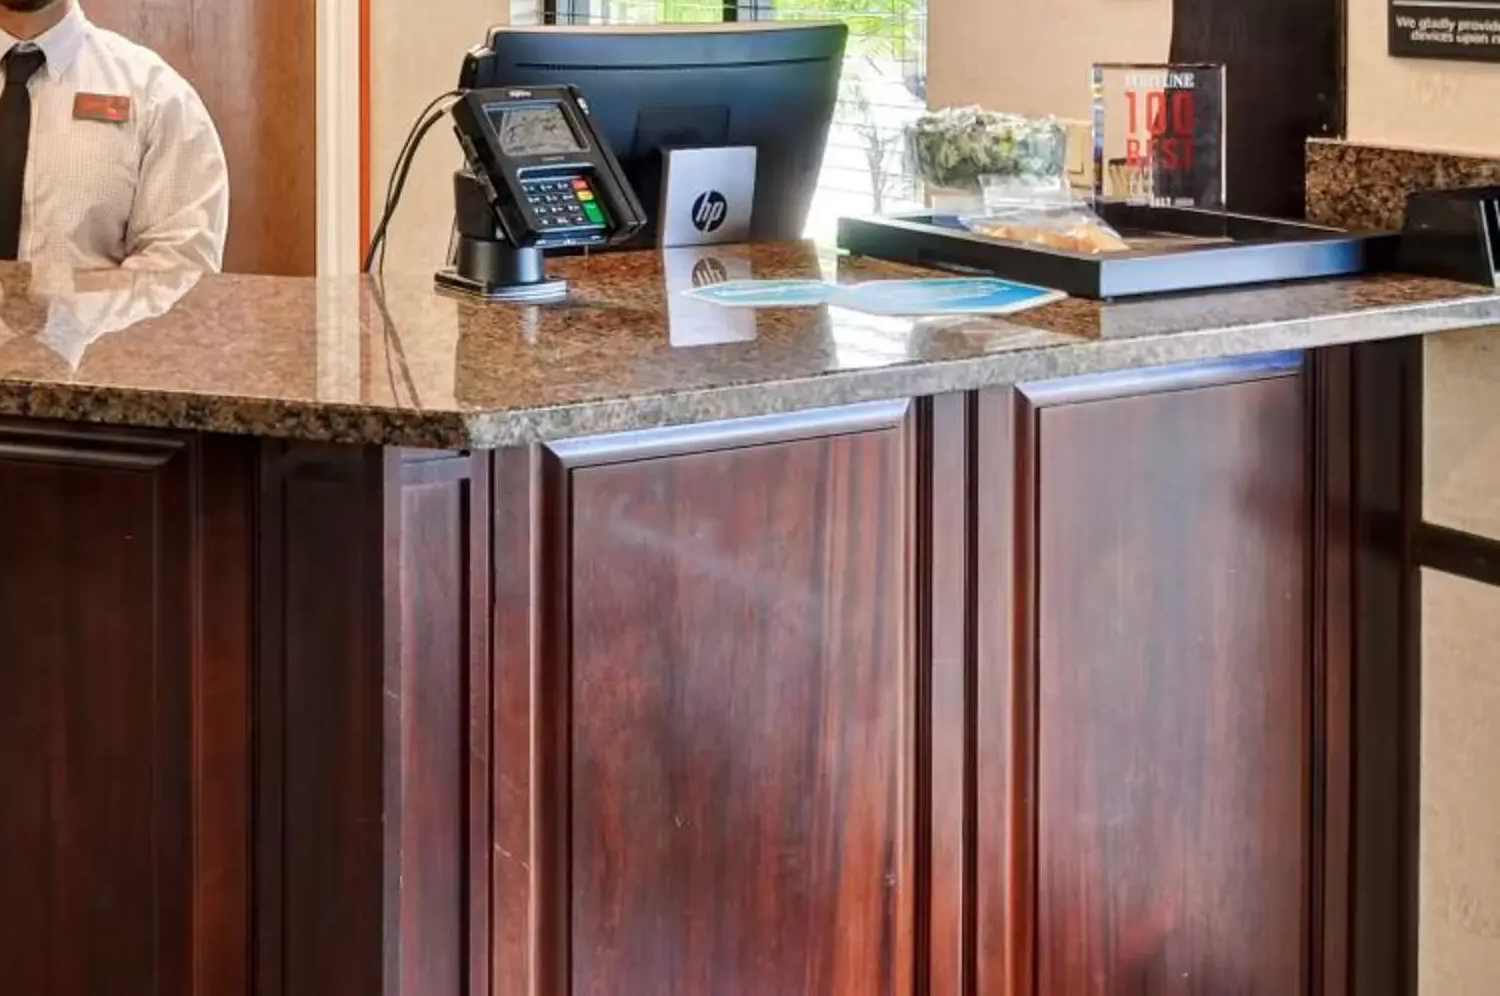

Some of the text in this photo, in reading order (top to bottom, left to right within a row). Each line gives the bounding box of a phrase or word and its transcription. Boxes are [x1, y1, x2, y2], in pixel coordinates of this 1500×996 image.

[1124, 91, 1195, 134] 100
[1126, 139, 1195, 169] BEST
[695, 190, 724, 233] hp
